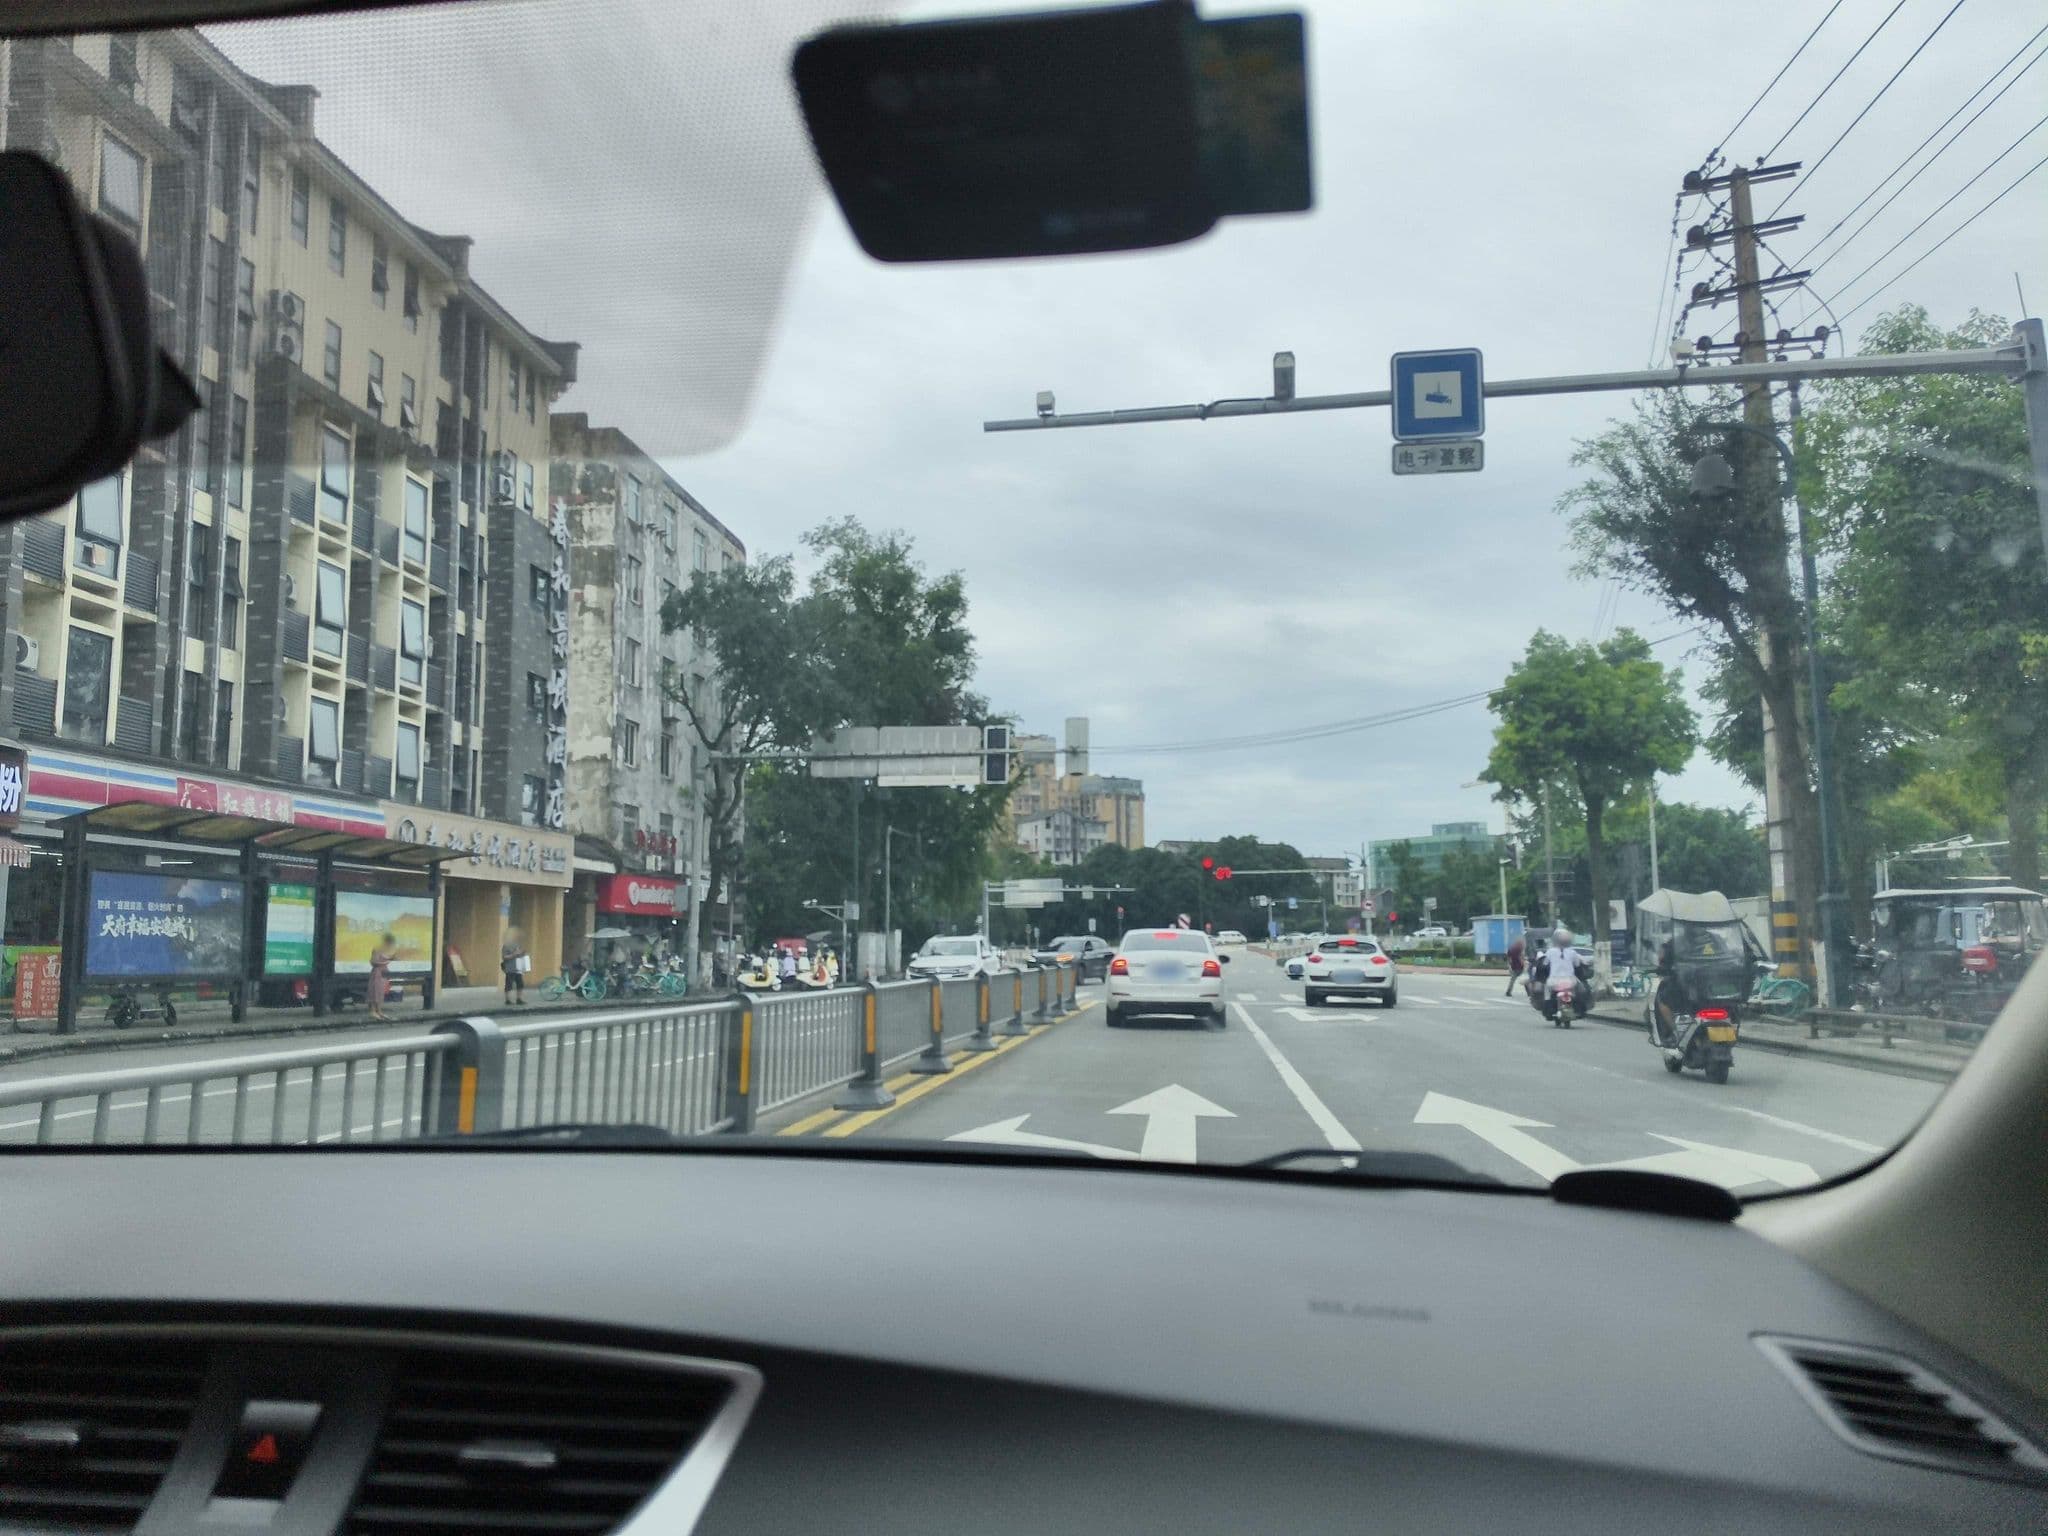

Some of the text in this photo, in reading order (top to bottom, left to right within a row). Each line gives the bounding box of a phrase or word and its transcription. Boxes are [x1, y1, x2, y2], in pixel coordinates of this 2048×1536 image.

[1398, 447, 1475, 468] 电子警察
[0, 763, 22, 812] 粉
